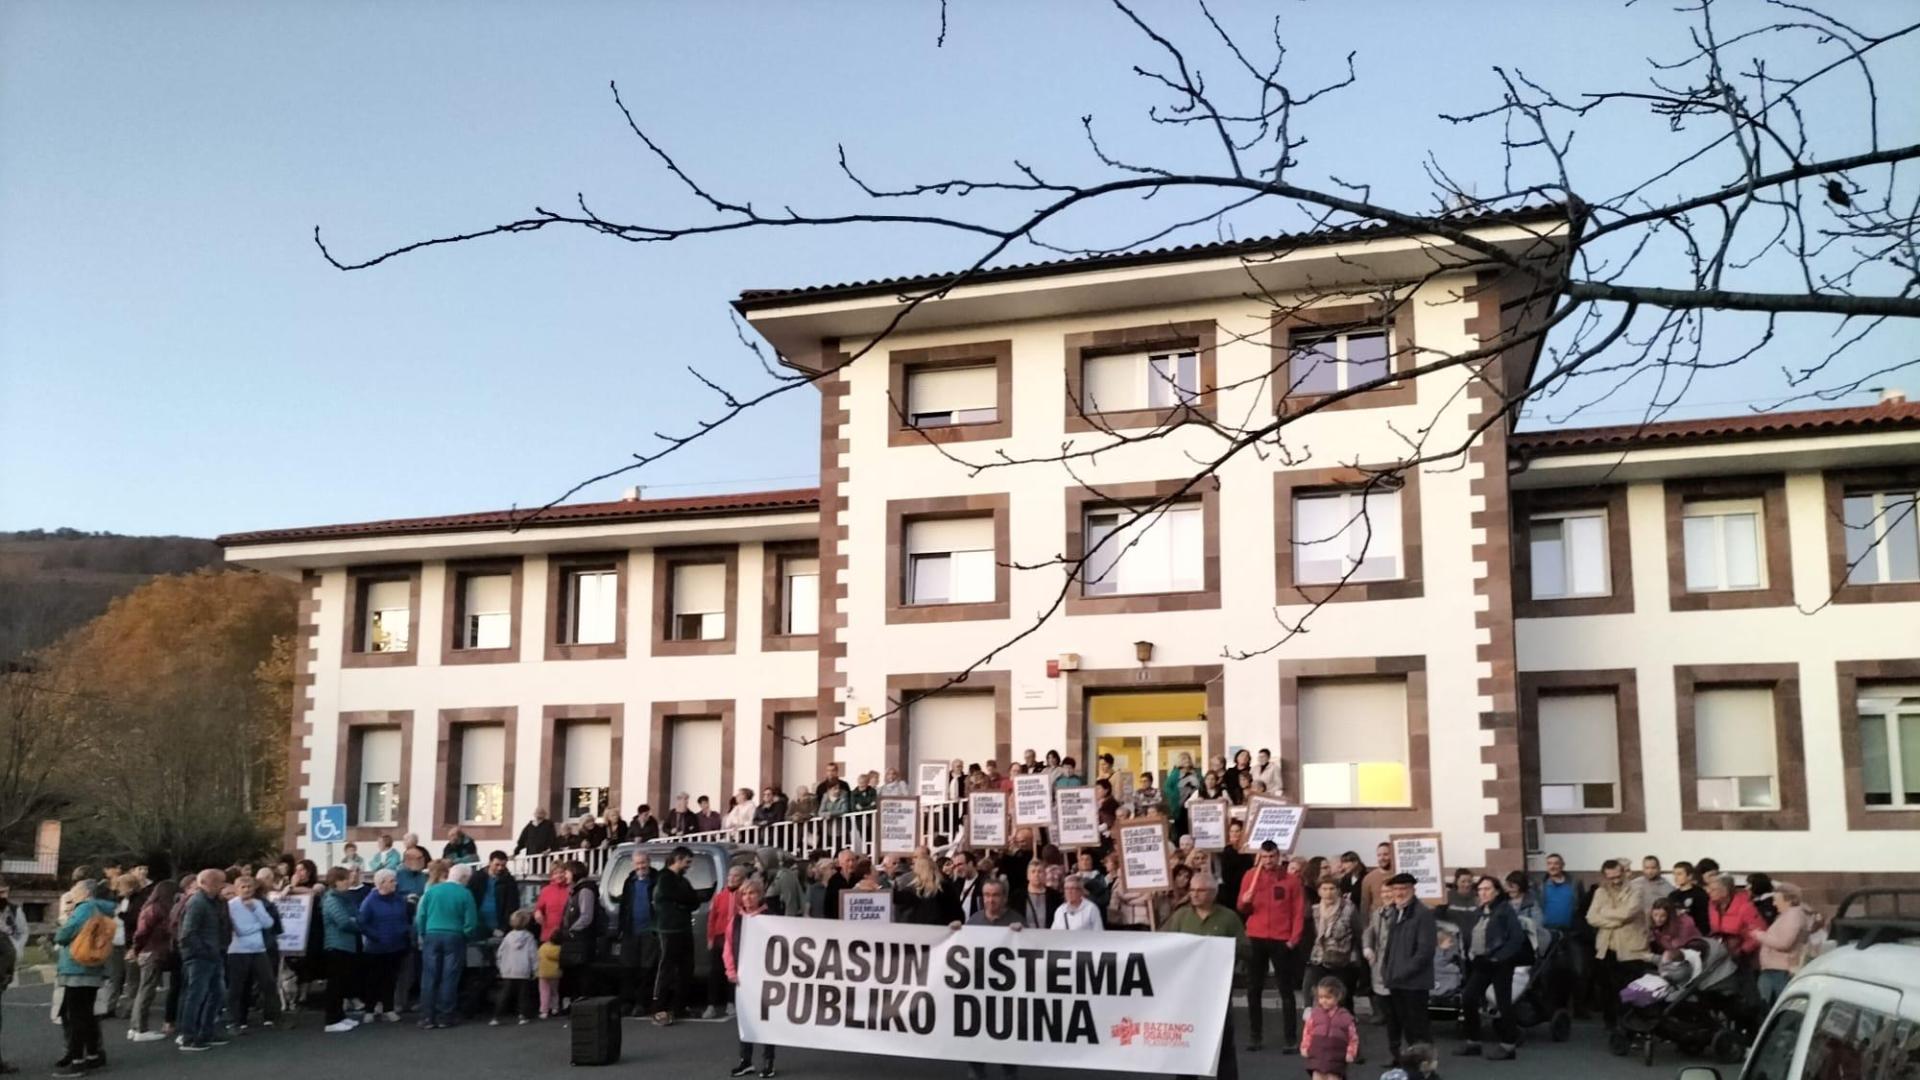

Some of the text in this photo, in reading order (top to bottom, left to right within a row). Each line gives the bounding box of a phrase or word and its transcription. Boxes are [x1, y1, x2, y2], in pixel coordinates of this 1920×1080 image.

[764, 935, 1154, 997] OSASUN SISTEMA
[760, 979, 1099, 1045] PUBLIKO DUINA
[1144, 1022, 1195, 1034] BAZTANGO
[1144, 1031, 1183, 1042] OSASUN
